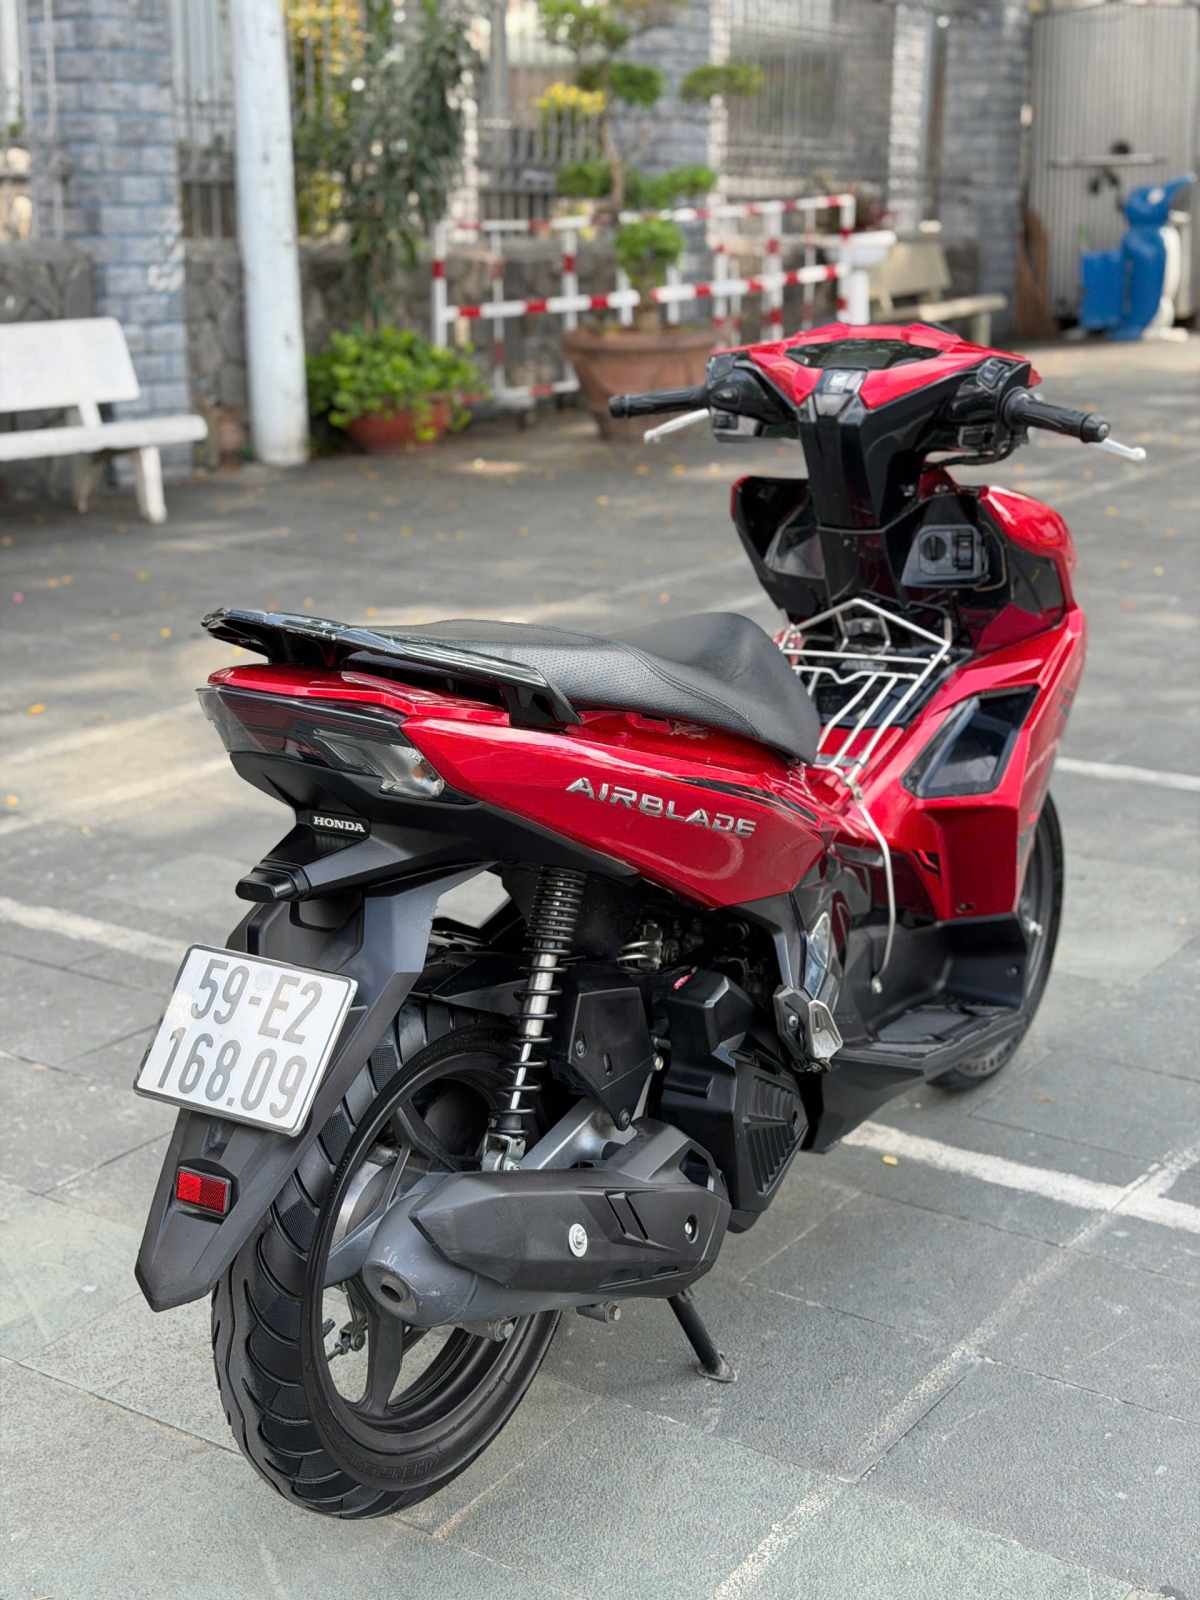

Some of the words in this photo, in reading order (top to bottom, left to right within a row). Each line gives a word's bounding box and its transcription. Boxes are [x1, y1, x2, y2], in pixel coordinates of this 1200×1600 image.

[313, 816, 365, 832] HONDA
[566, 777, 757, 838] AIRBLADE
[190, 959, 323, 1045] 59-E2
[157, 1027, 307, 1118] 168.09
